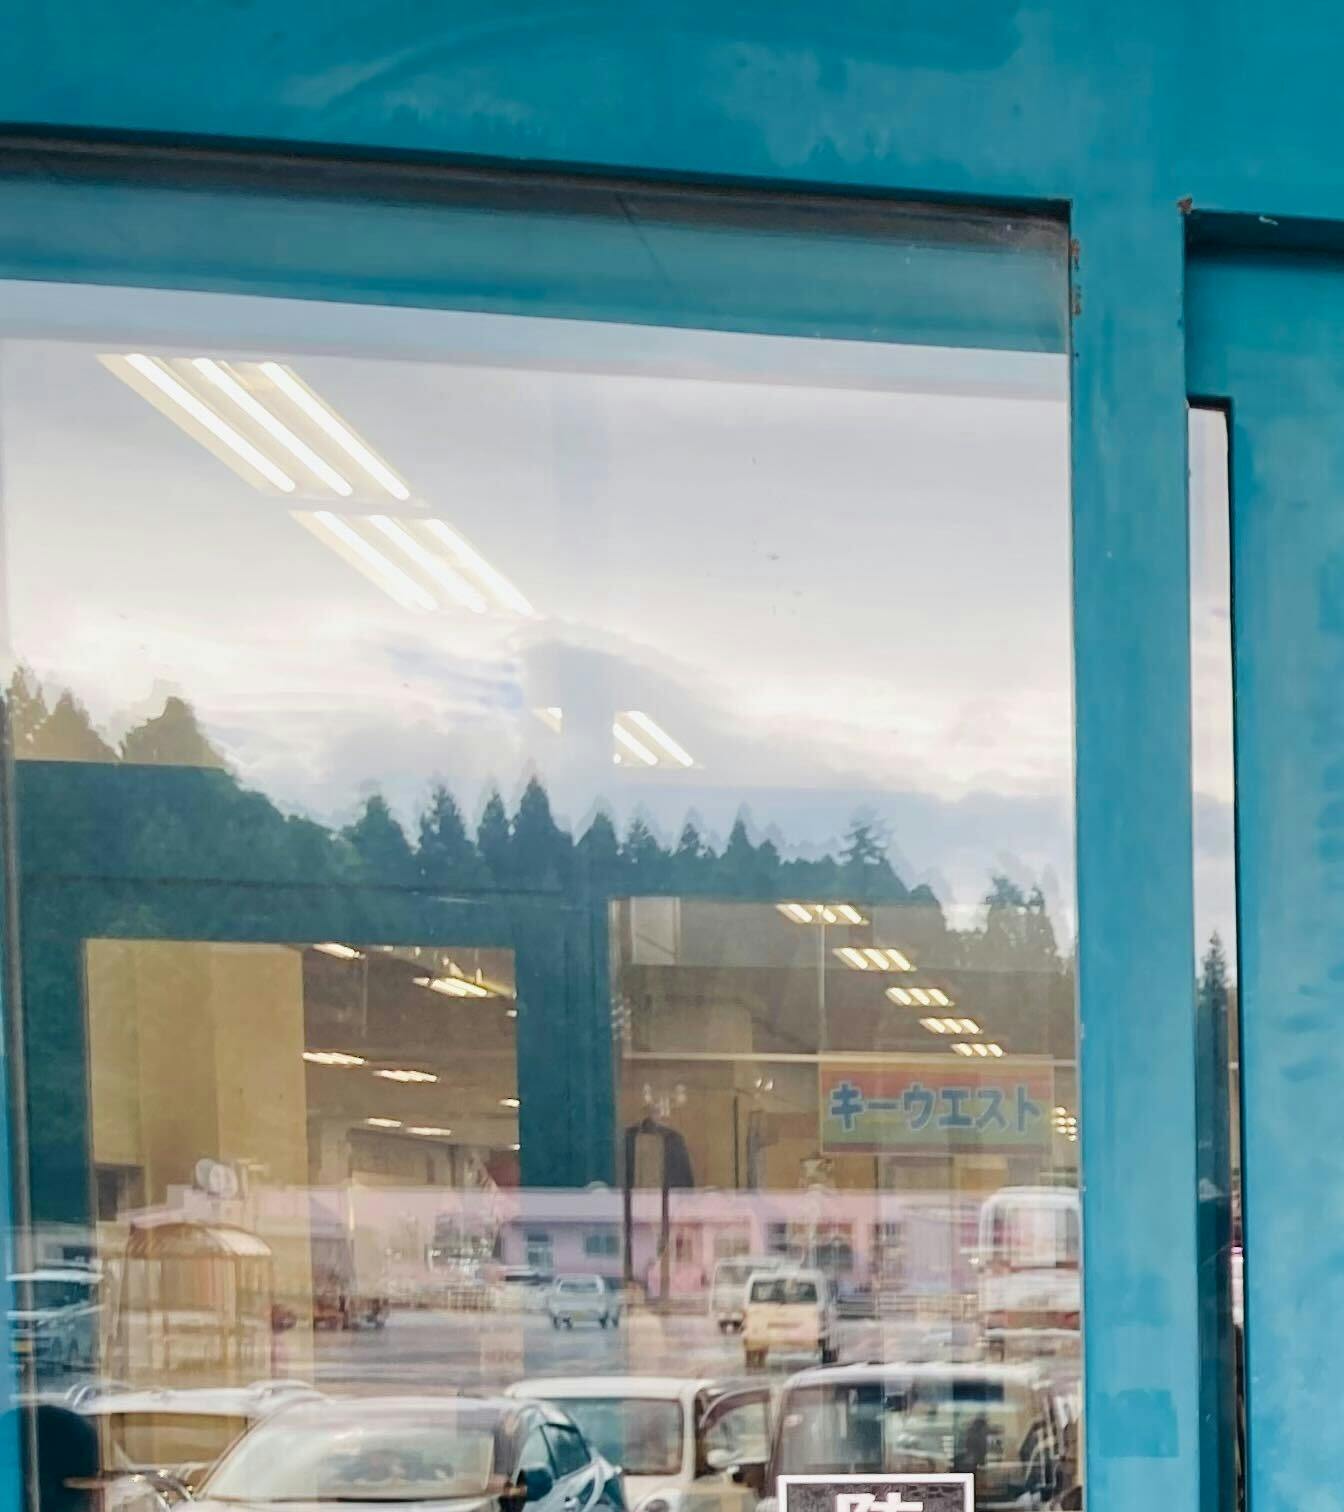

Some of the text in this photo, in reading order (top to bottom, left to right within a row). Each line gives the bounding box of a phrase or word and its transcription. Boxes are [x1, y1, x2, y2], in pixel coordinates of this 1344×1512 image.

[830, 1081, 1042, 1132] キーウエスト
